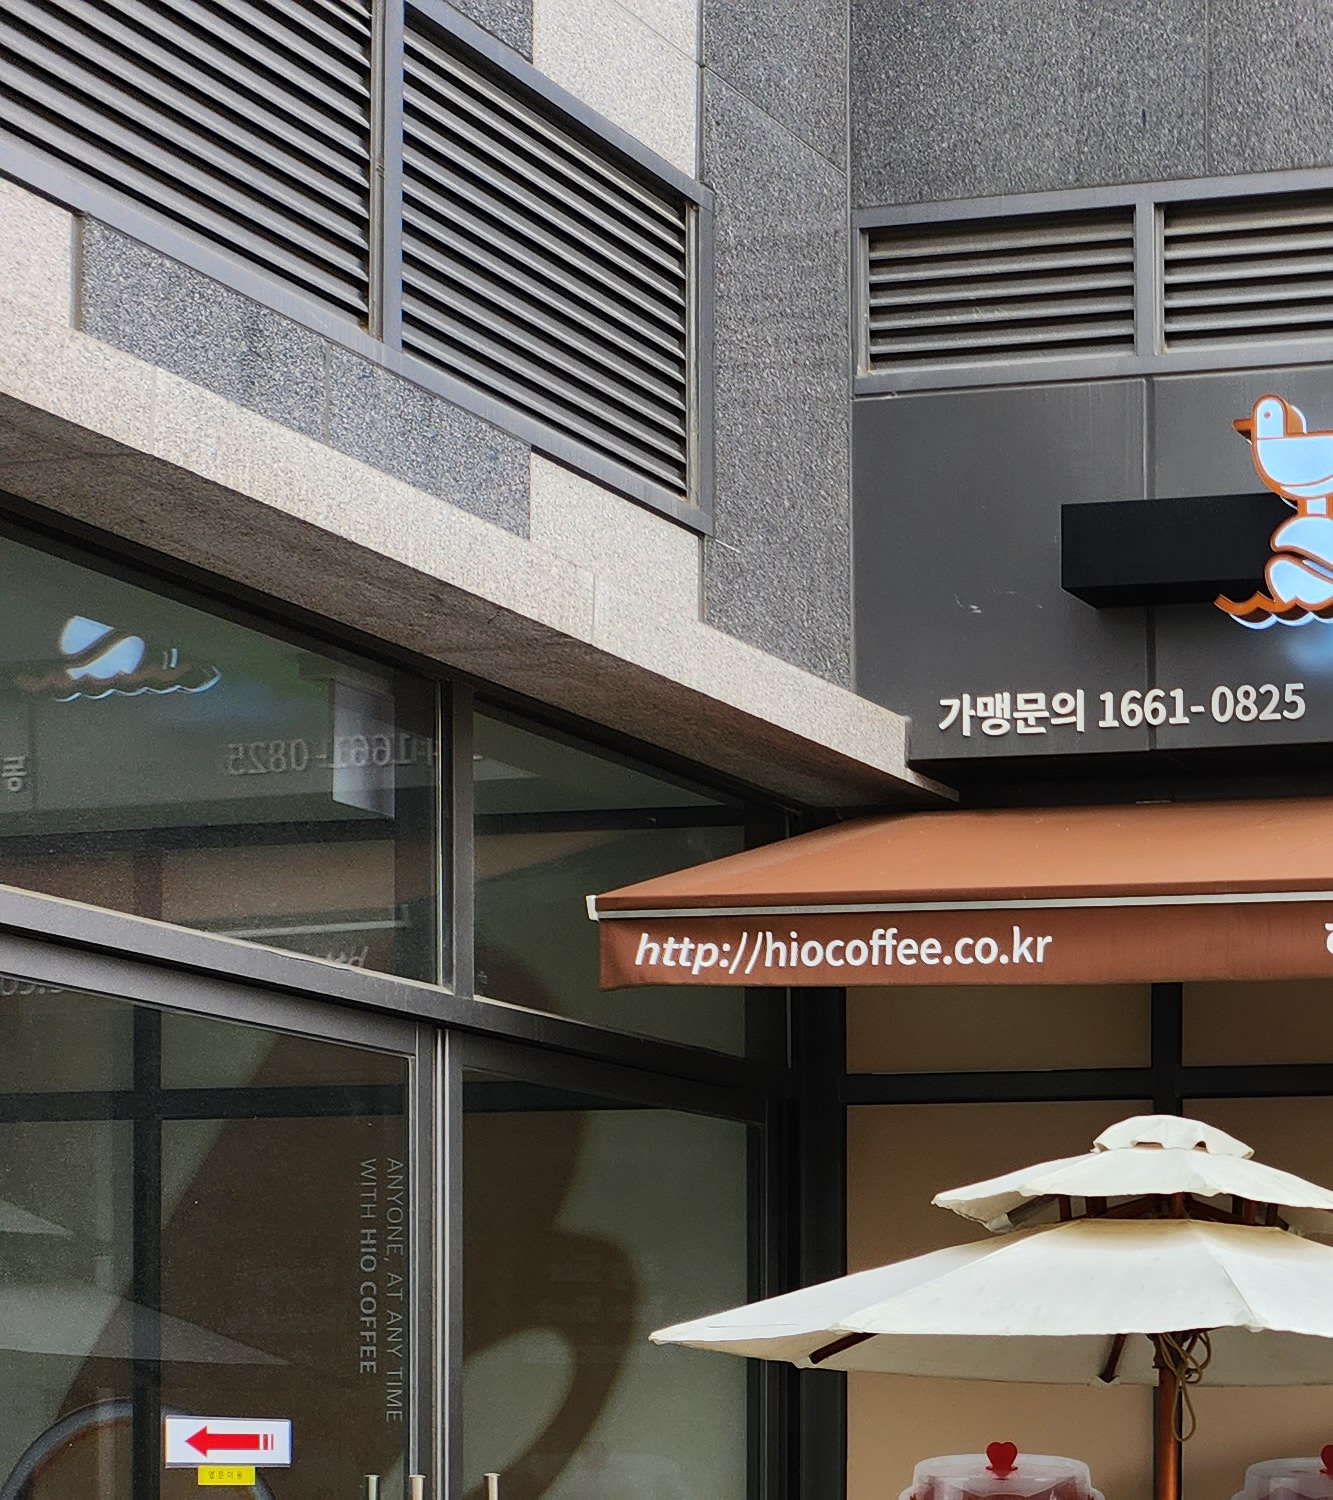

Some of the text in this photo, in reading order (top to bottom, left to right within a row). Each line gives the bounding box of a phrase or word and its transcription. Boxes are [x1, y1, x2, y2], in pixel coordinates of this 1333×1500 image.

[938, 680, 1308, 742] 가맹문의 1661-0825
[632, 924, 1054, 977] http://hiocoffee.co.kr
[360, 1158, 377, 1374] WITH HIO COFFEE
[384, 1157, 404, 1423] ANYONE, AT ANY TIME
